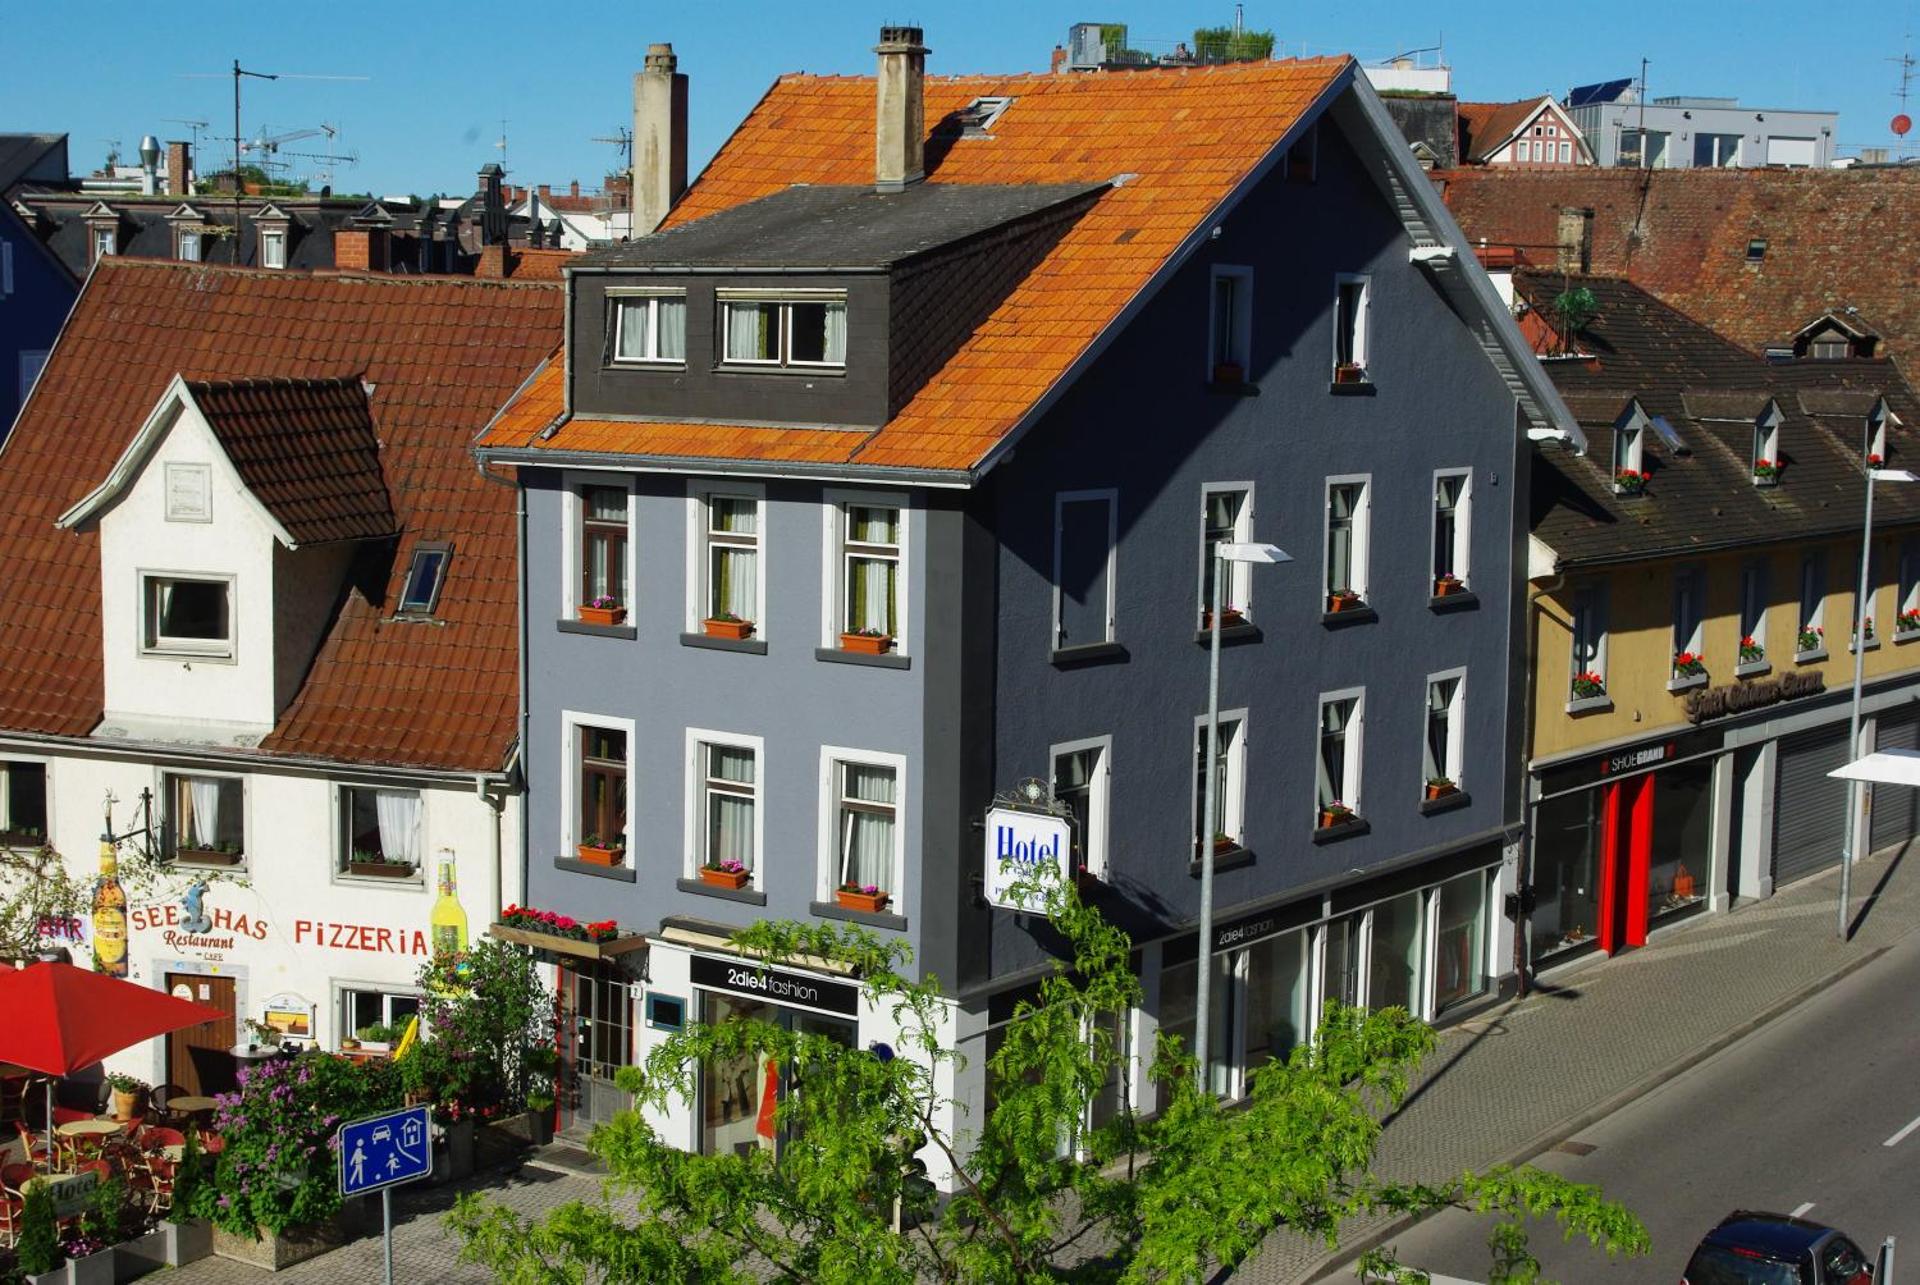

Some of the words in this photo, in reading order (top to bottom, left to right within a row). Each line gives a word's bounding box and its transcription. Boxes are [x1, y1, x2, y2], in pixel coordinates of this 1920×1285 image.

[997, 825, 1059, 865] Hotel
[131, 905, 180, 931] SEE
[213, 908, 268, 940] HAS
[163, 930, 235, 955] Restaurant
[768, 975, 818, 1001] fashion
